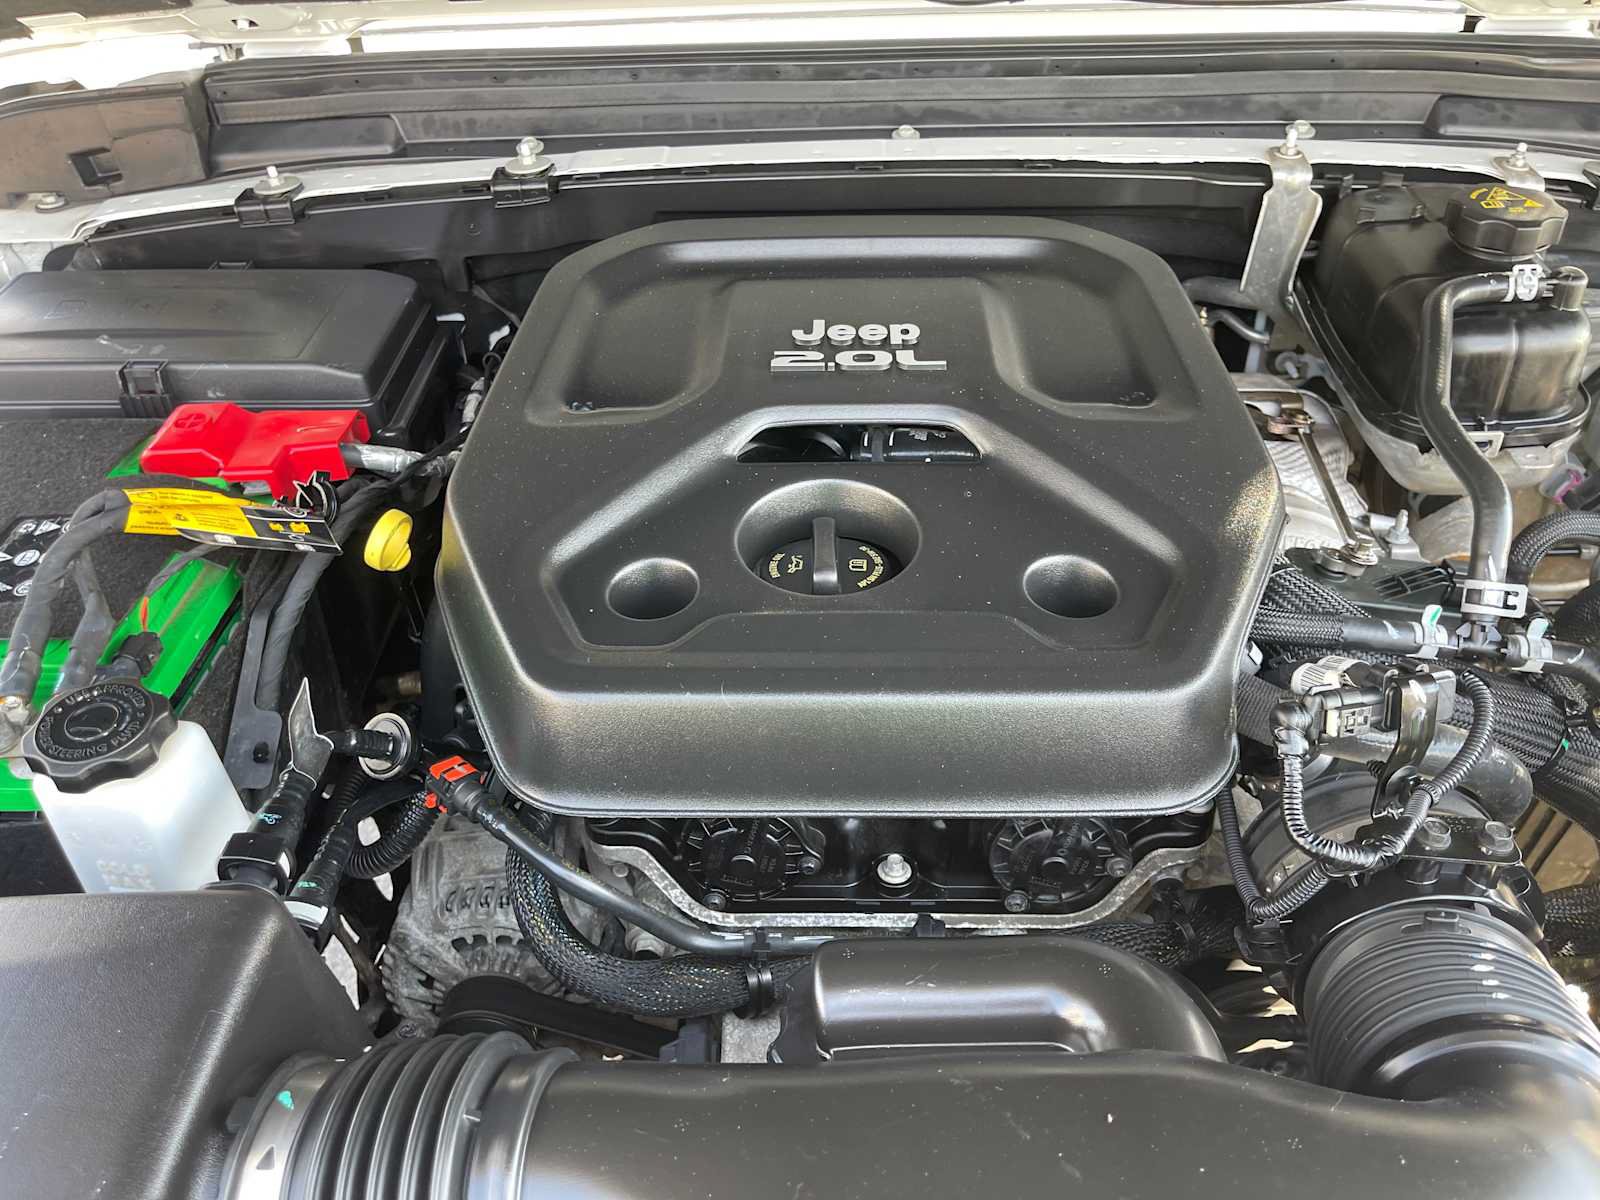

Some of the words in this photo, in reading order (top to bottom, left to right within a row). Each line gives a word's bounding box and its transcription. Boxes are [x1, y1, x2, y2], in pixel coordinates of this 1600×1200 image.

[791, 319, 921, 345] Jeep
[770, 350, 947, 371] 2.0L
[48, 744, 108, 759] STEERING
